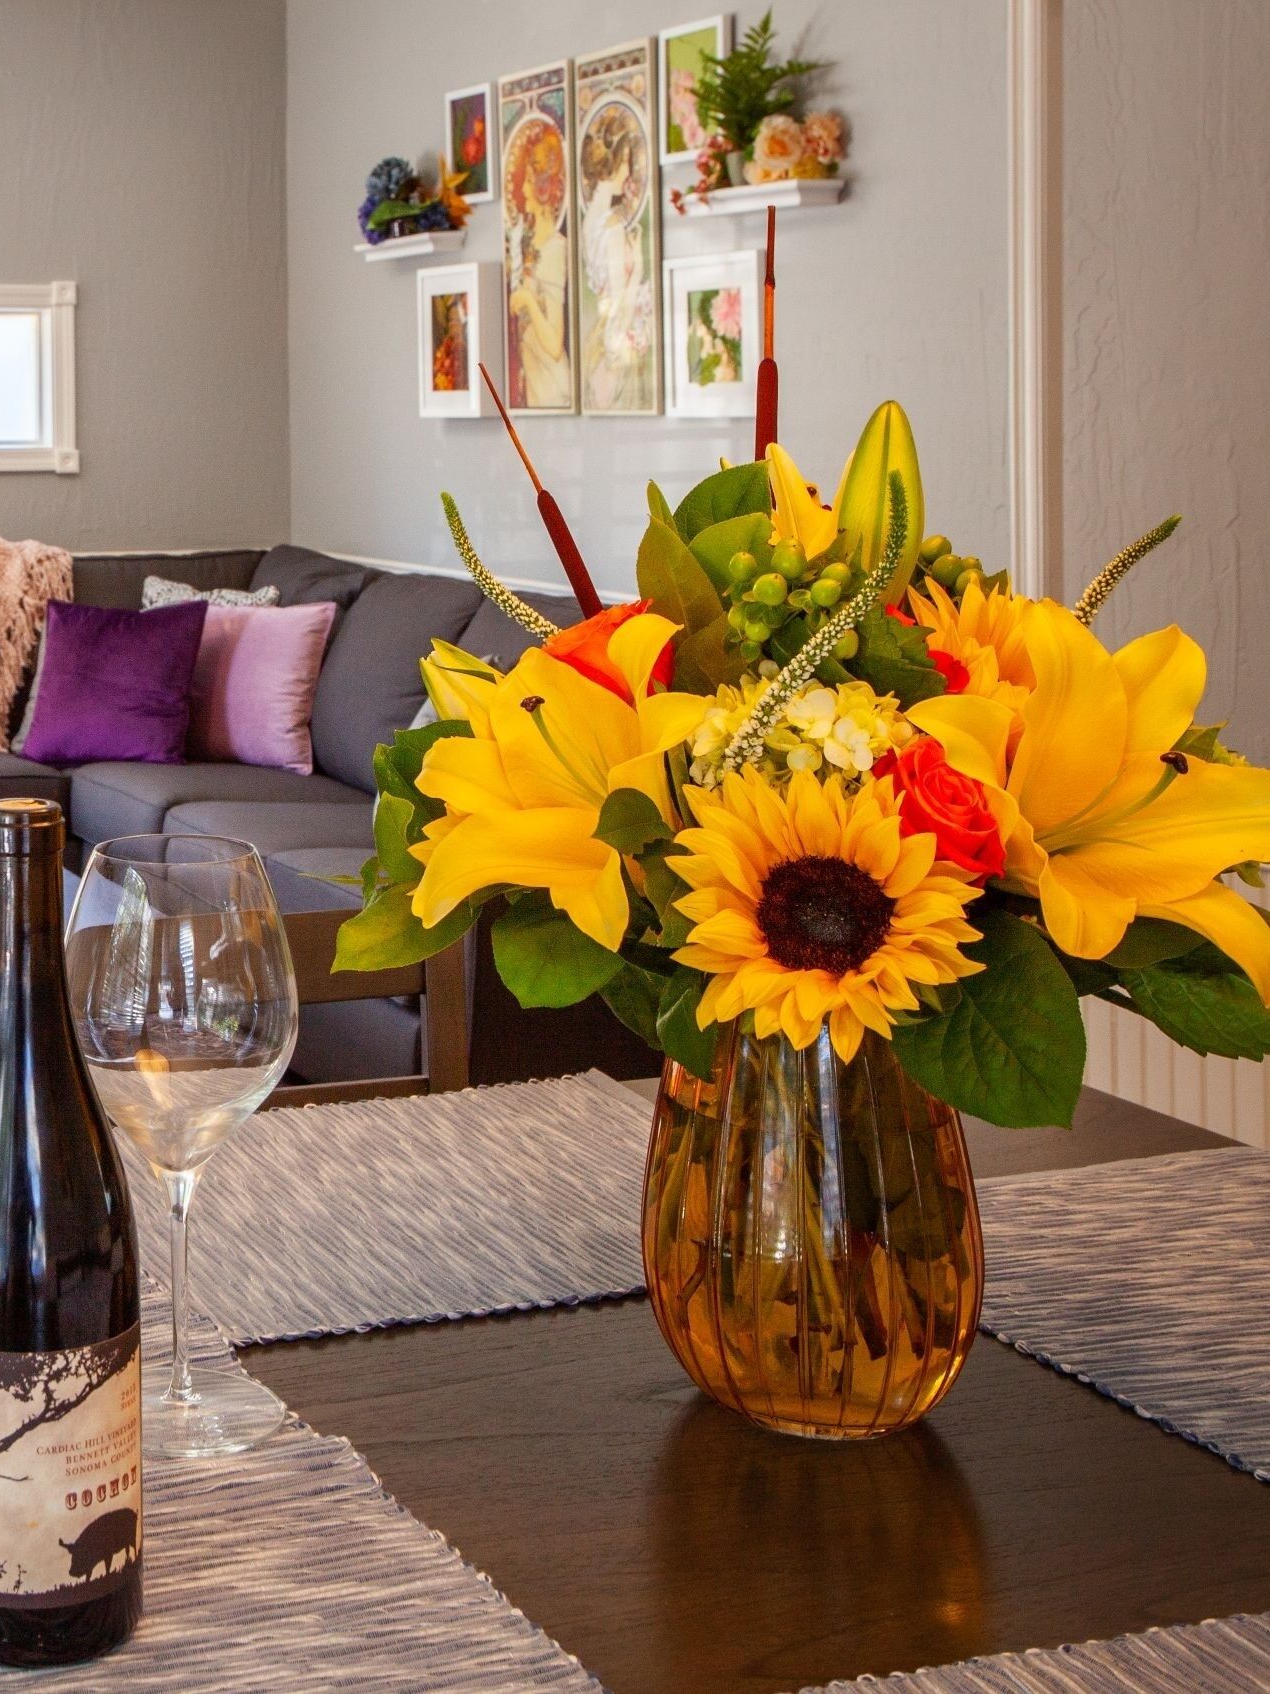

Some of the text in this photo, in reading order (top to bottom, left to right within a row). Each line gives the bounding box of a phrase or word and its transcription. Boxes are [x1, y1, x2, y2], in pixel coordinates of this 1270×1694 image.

[36, 1442, 82, 1455] CARDIAC
[85, 1435, 105, 1448] HILL
[66, 1430, 137, 1464] BENNETT VALLEY
[66, 1442, 137, 1476] SONOMA COUNTY
[65, 1465, 137, 1510] COCHON
